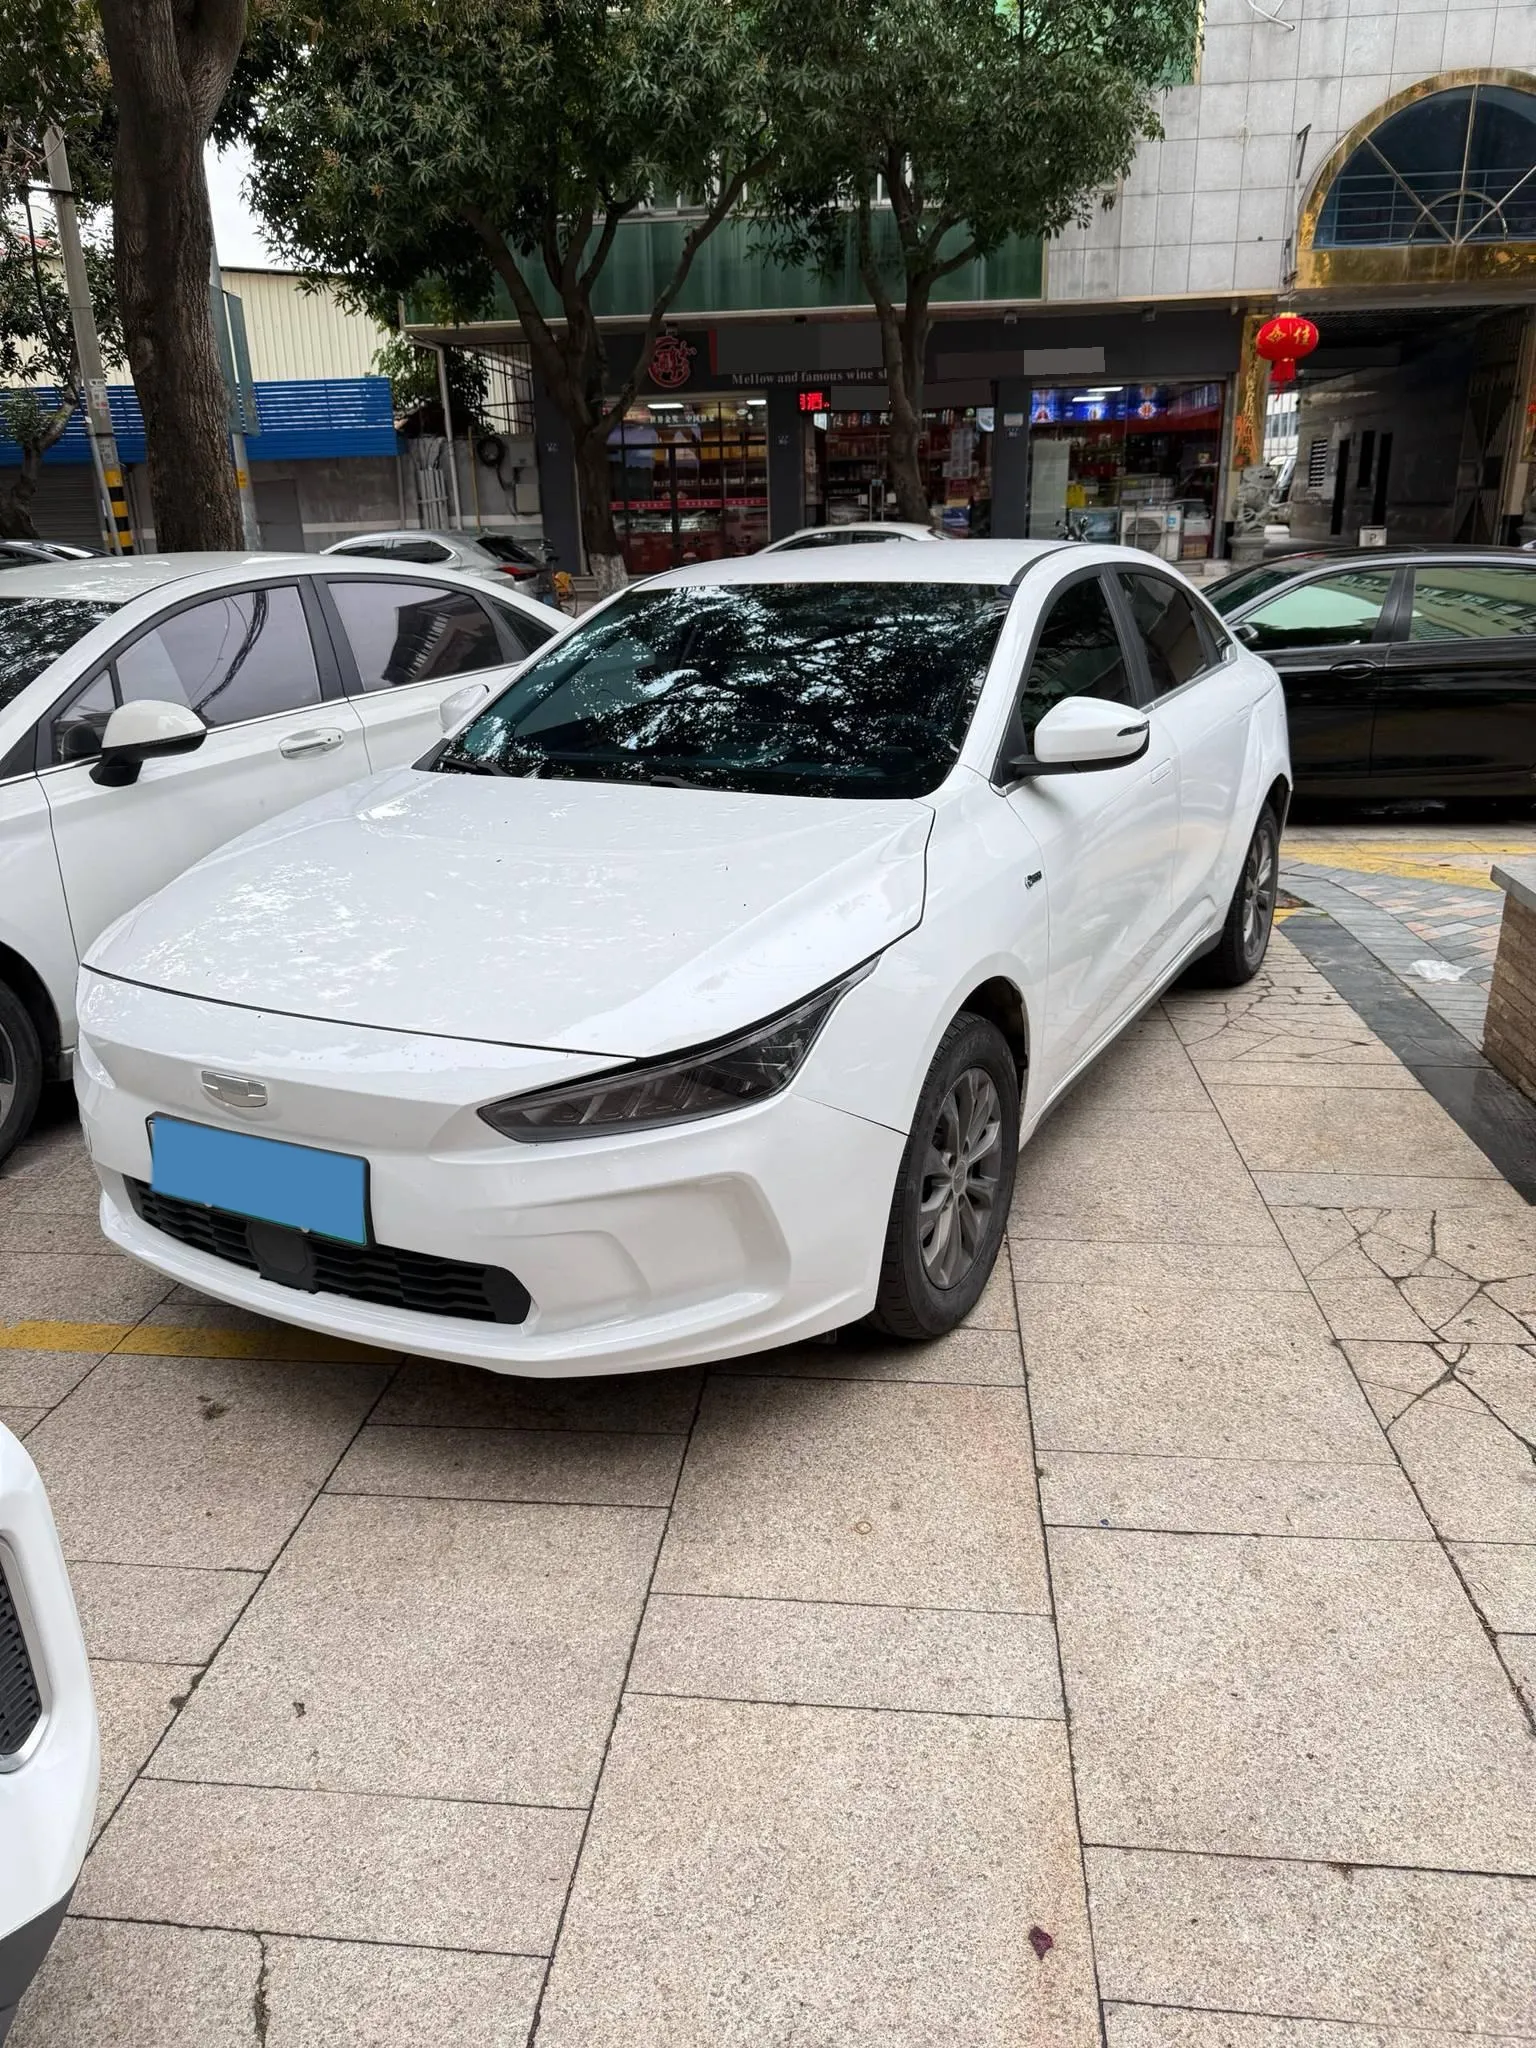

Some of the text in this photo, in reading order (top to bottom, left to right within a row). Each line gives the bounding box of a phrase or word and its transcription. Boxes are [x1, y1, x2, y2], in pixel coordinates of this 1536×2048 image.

[732, 373, 774, 385] Mellow
[778, 371, 797, 383] and
[801, 371, 843, 382] famous
[847, 369, 873, 379] wine
